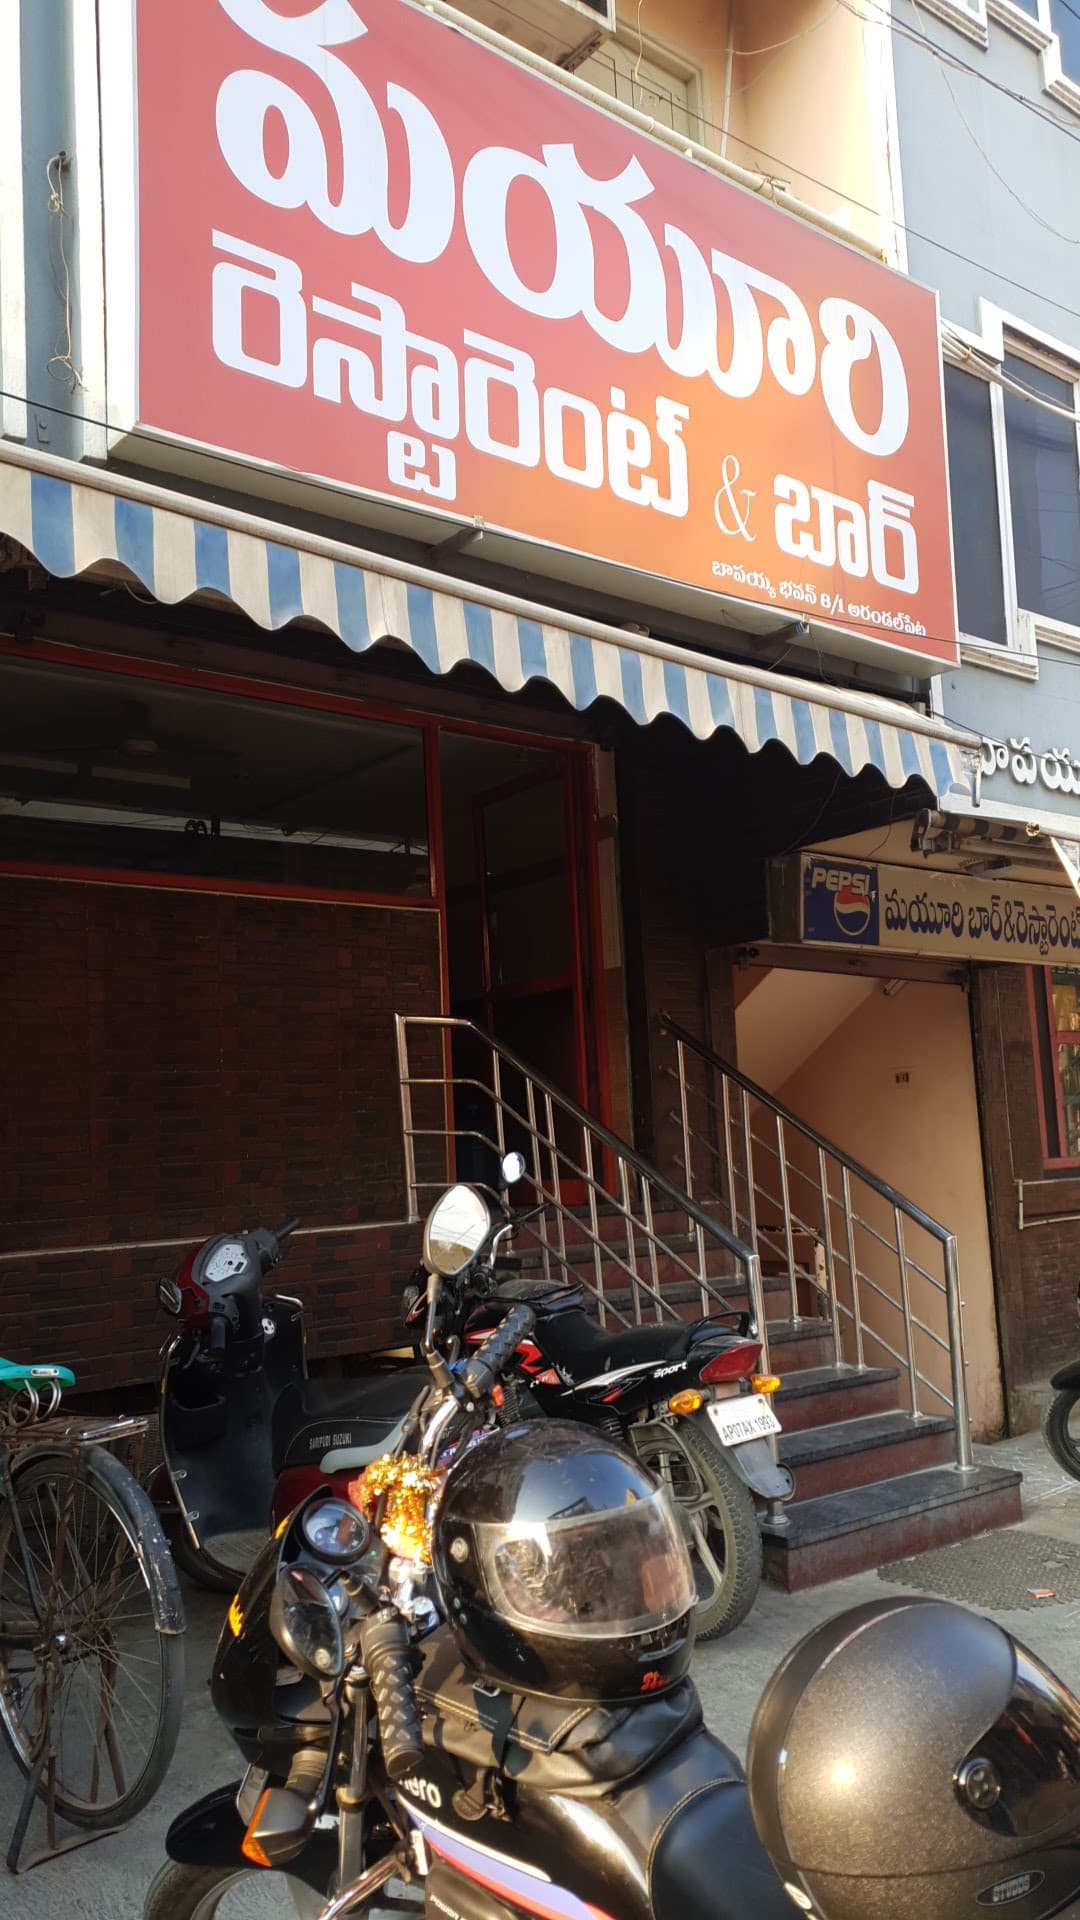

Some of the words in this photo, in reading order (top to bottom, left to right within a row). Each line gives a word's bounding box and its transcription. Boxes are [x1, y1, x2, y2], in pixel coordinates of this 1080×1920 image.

[212, 228, 690, 518] రెస్టారెంట్
[714, 454, 757, 542] &
[773, 474, 919, 594] బార్
[711, 560, 777, 599] బాపయ్య
[779, 580, 817, 605] భవన్
[820, 592, 845, 616] 8/1
[811, 866, 870, 897] PEPSI
[885, 888, 964, 938] మయూరి
[721, 1419, 757, 1441] AP07AX
